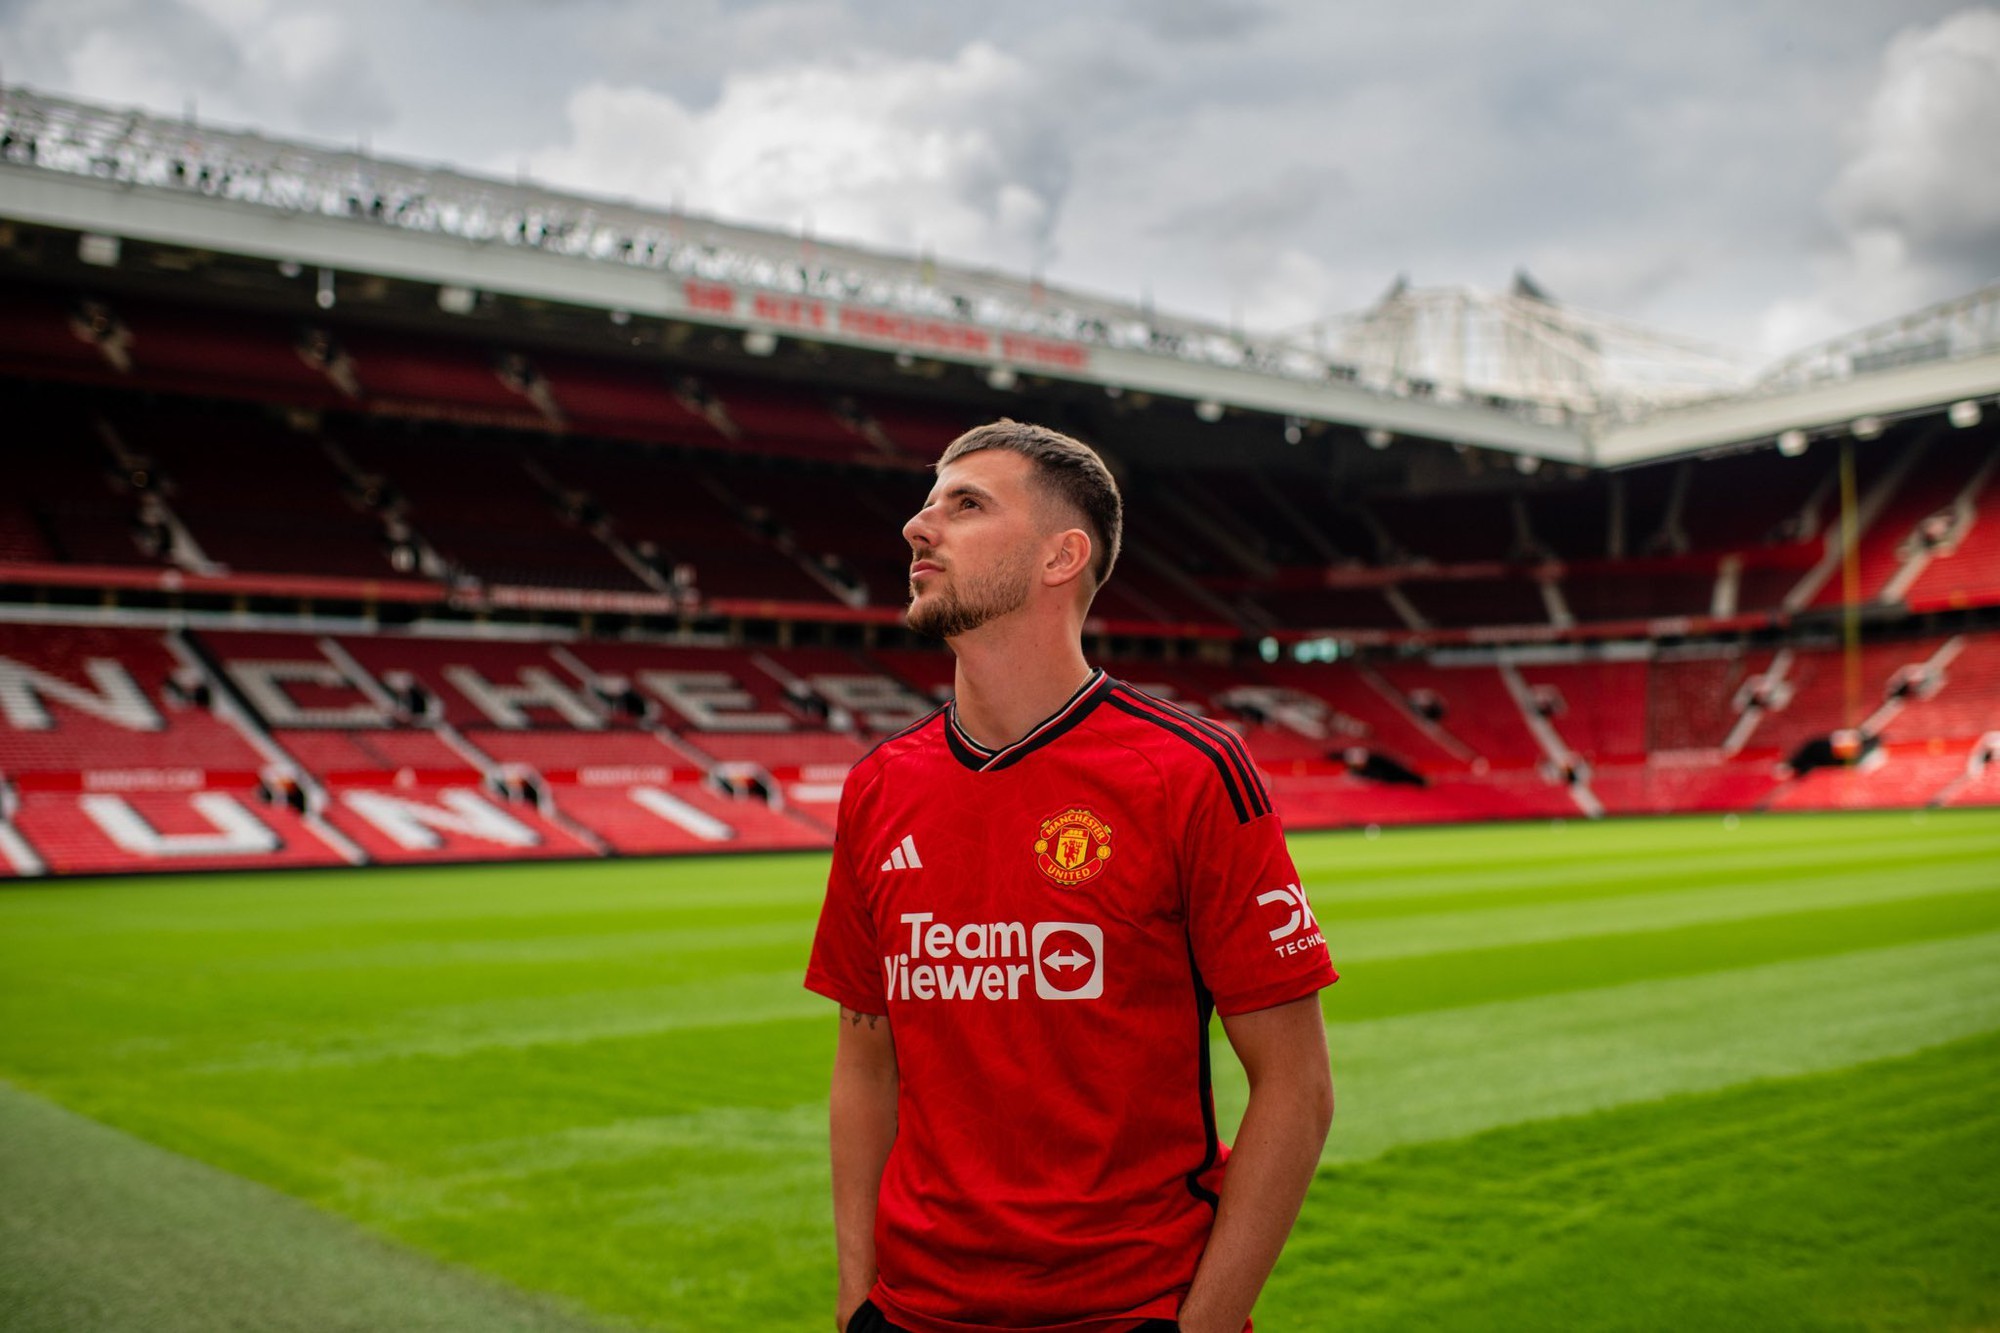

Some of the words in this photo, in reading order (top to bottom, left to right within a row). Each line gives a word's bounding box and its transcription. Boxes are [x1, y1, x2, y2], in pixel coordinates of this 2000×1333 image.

[1045, 814, 1106, 841] MANCHESTER
[1047, 864, 1091, 880] UNITED
[900, 912, 1028, 959] Team
[1275, 931, 1326, 958] TECHN
[884, 953, 1029, 1001] Viewer
